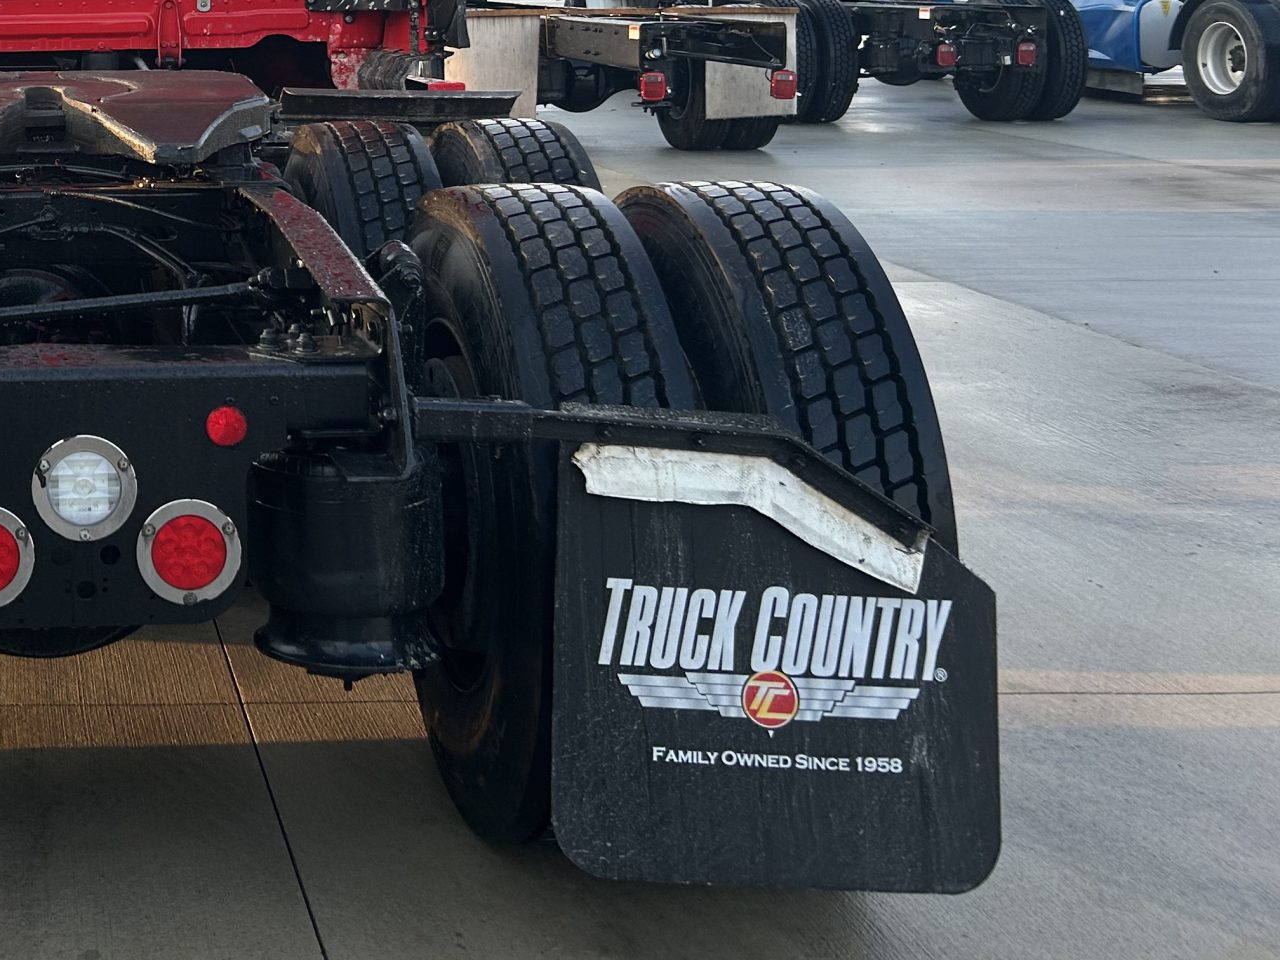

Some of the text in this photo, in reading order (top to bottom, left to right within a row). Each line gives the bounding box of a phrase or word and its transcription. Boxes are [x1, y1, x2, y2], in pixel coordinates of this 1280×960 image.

[598, 577, 746, 671] TRUCK
[652, 747, 903, 773] FAMILY OWNED SINCE 1958
